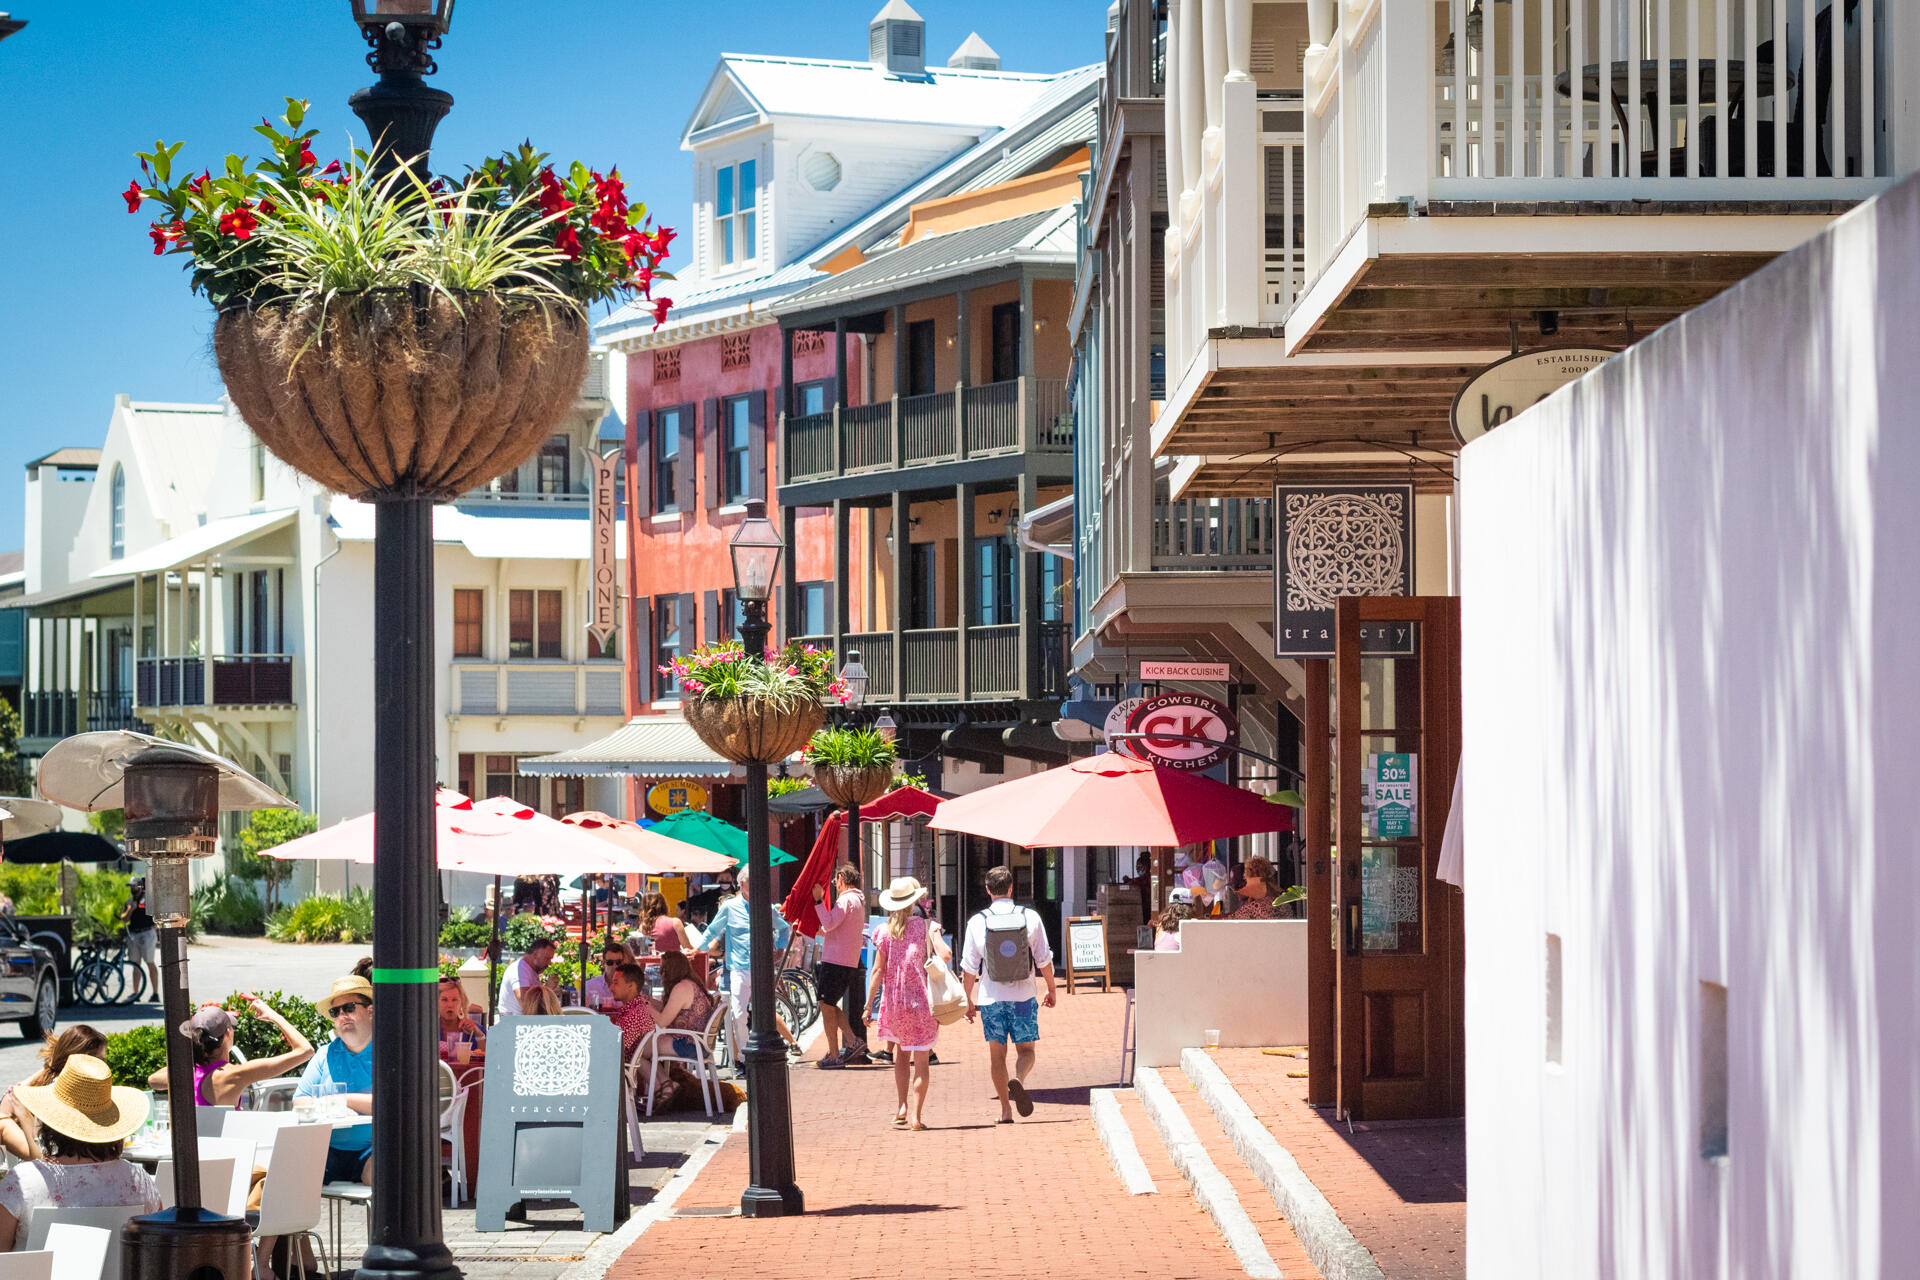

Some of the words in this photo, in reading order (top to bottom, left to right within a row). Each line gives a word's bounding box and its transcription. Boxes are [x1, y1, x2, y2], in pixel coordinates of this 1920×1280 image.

[1536, 355, 1610, 365] ESTABLISHE
[1561, 366, 1589, 374] 2009
[597, 468, 613, 624] PENSIONE
[1285, 628, 1406, 644] traery
[1145, 666, 1166, 675] KICK
[1166, 667, 1189, 675] BACK
[1191, 667, 1225, 676] CUISINE
[1146, 696, 1219, 713] COWGIRL
[1144, 716, 1214, 748] CK
[1146, 752, 1219, 768] KITCHEN
[1375, 788, 1412, 800] SALE
[1073, 943, 1091, 951] Join
[1076, 955, 1102, 963] lunch!
[510, 1105, 589, 1116] tracery
